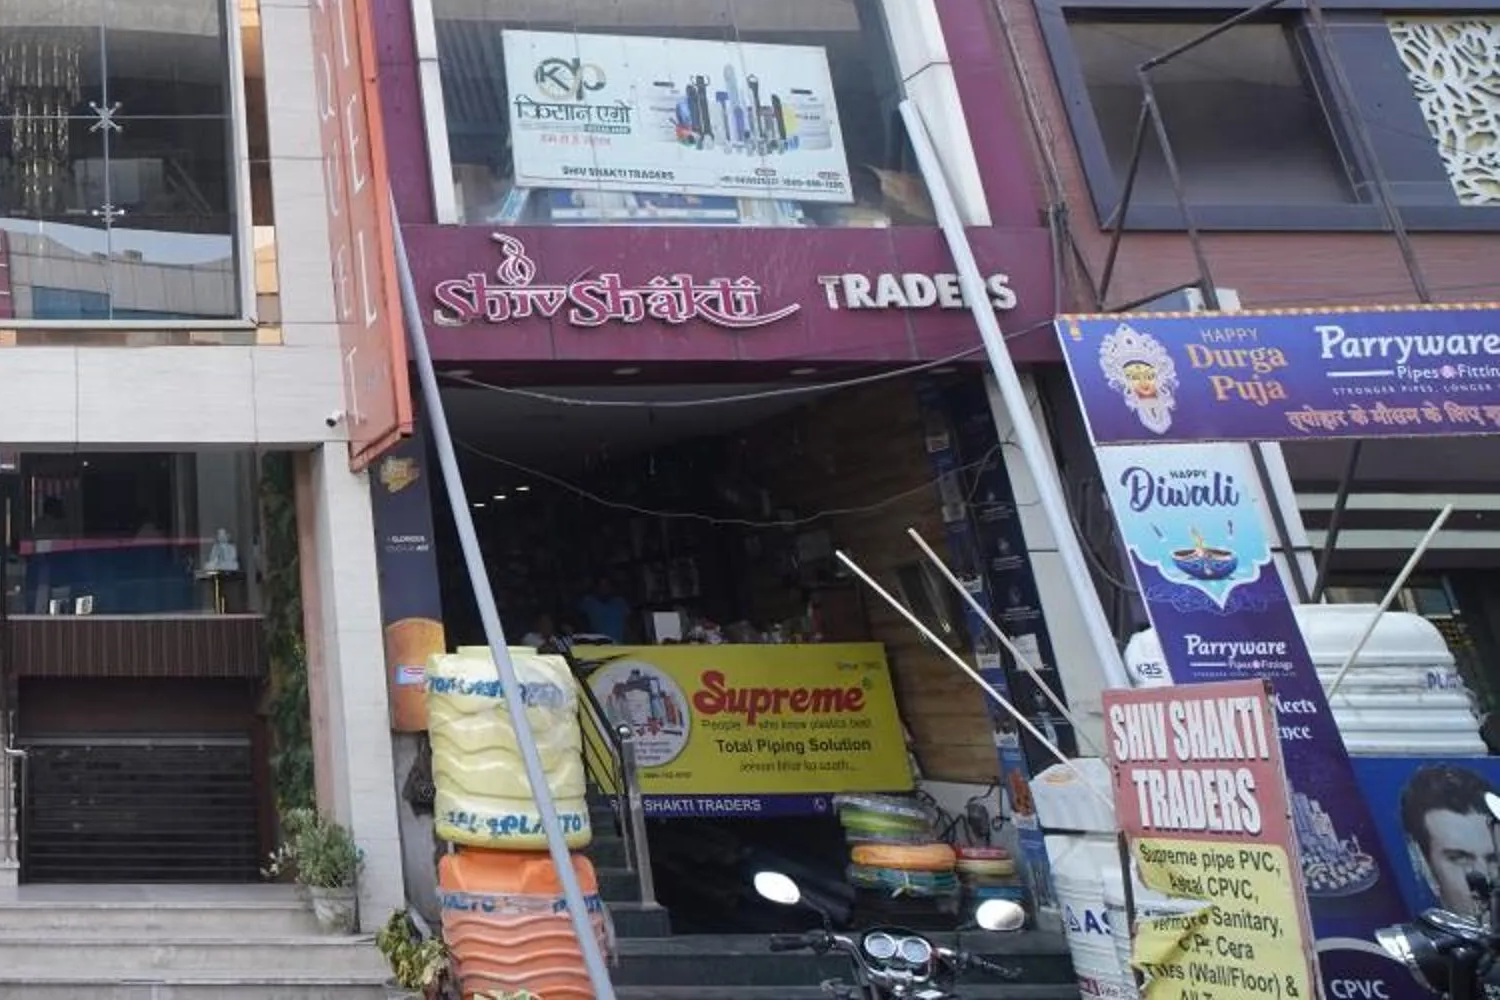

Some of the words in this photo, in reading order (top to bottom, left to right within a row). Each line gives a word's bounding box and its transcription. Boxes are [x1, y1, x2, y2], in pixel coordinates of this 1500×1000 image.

[513, 93, 593, 122] किसान
[1201, 328, 1259, 342] HAPPY
[1314, 324, 1500, 364] Parryware
[1185, 344, 1289, 372] Durga
[1396, 365, 1439, 382] Pipes
[1208, 374, 1289, 406] Puja
[1120, 466, 1240, 512] Diwali
[1184, 633, 1287, 659] Parryware
[692, 669, 867, 727] Supreme
[1275, 692, 1317, 713] eets
[1109, 701, 1168, 762] SHIV
[1172, 695, 1271, 761] SHAKTI
[715, 738, 754, 753] Total
[757, 738, 805, 755] Piping
[810, 738, 872, 752] Solution
[644, 799, 694, 812] SHAKTI
[698, 798, 763, 812] TRADERS
[1132, 766, 1262, 836] TRADERS
[1140, 843, 1197, 868] Supreme
[1202, 851, 1235, 872] pipe
[1239, 850, 1282, 878] PVC,
[1207, 877, 1260, 905] CPVC,
[1216, 936, 1255, 960] Cera
[1189, 963, 1282, 998] (Wall/Floor)
[1286, 976, 1300, 998] &
[1331, 979, 1390, 998] CPVC
